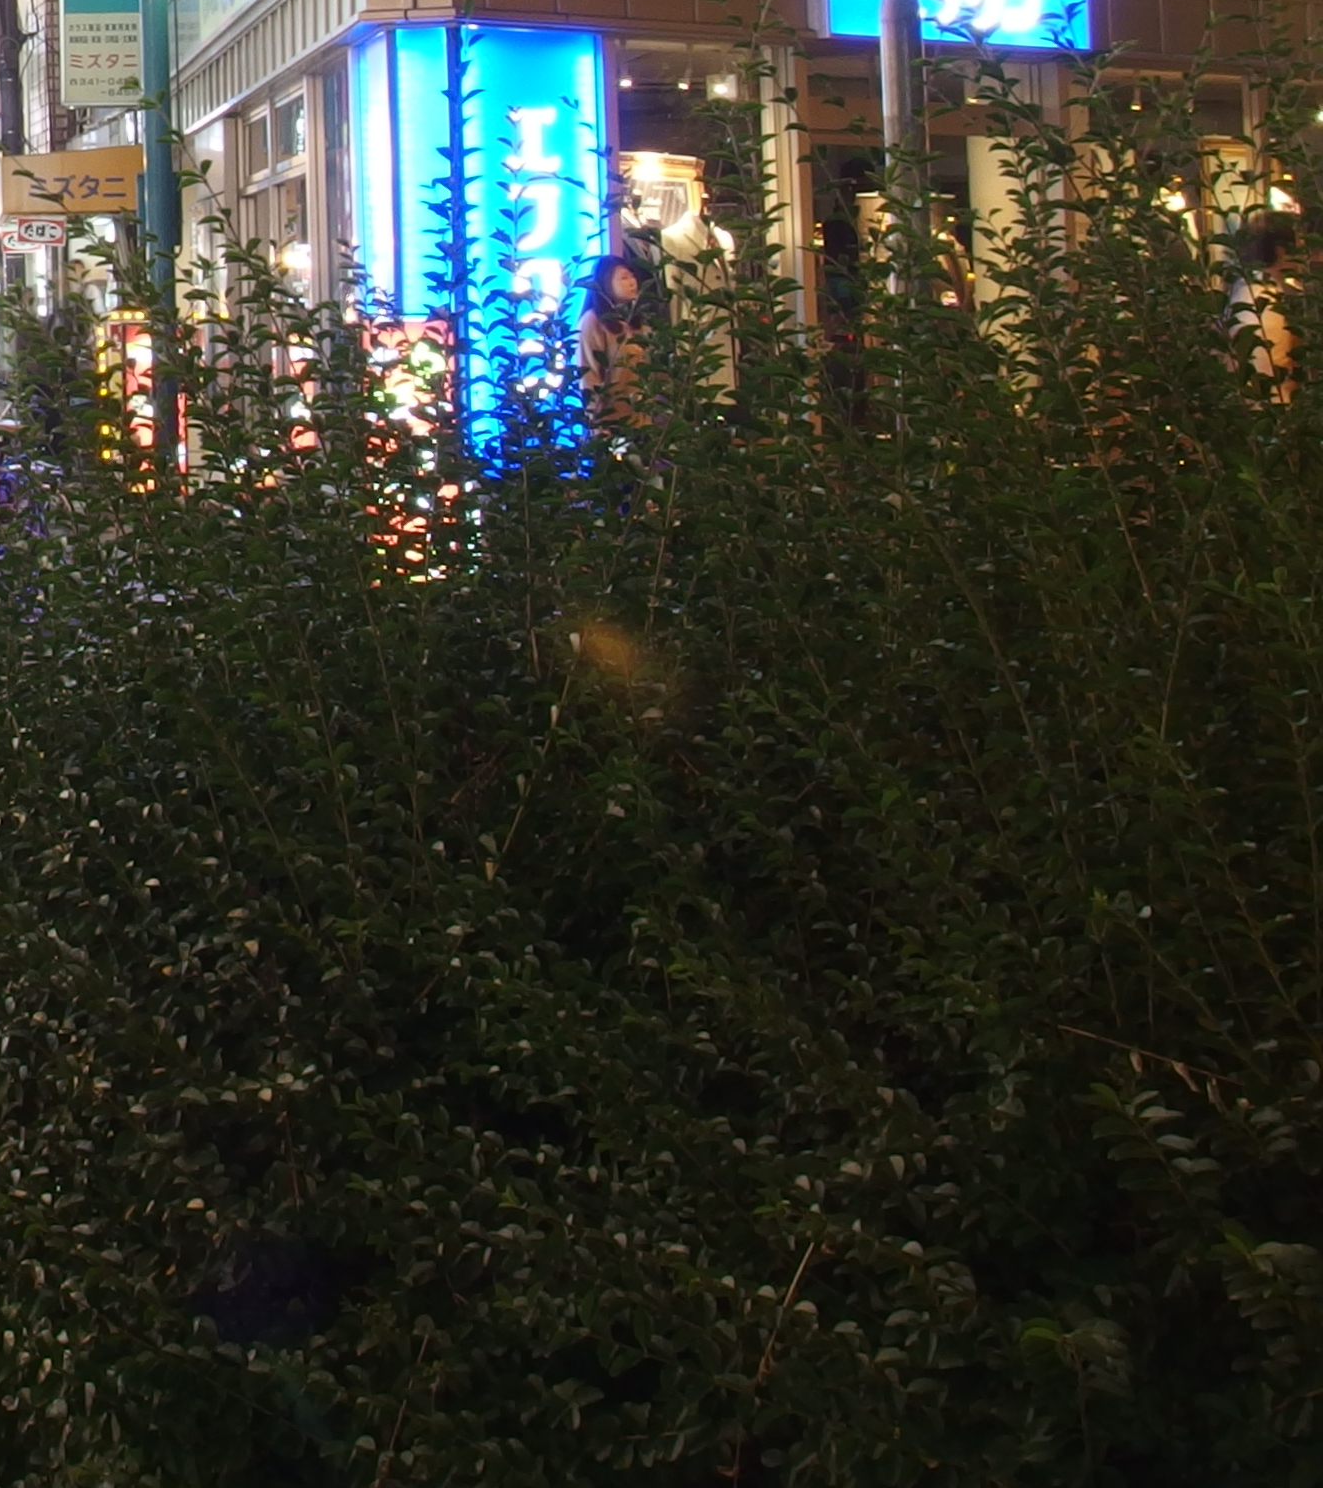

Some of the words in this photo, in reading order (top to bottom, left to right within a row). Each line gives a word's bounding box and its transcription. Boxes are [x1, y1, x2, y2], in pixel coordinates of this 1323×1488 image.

[69, 53, 138, 69] ミズタニ
[28, 174, 127, 200] ミズタニ
[23, 223, 59, 239] たばこ
